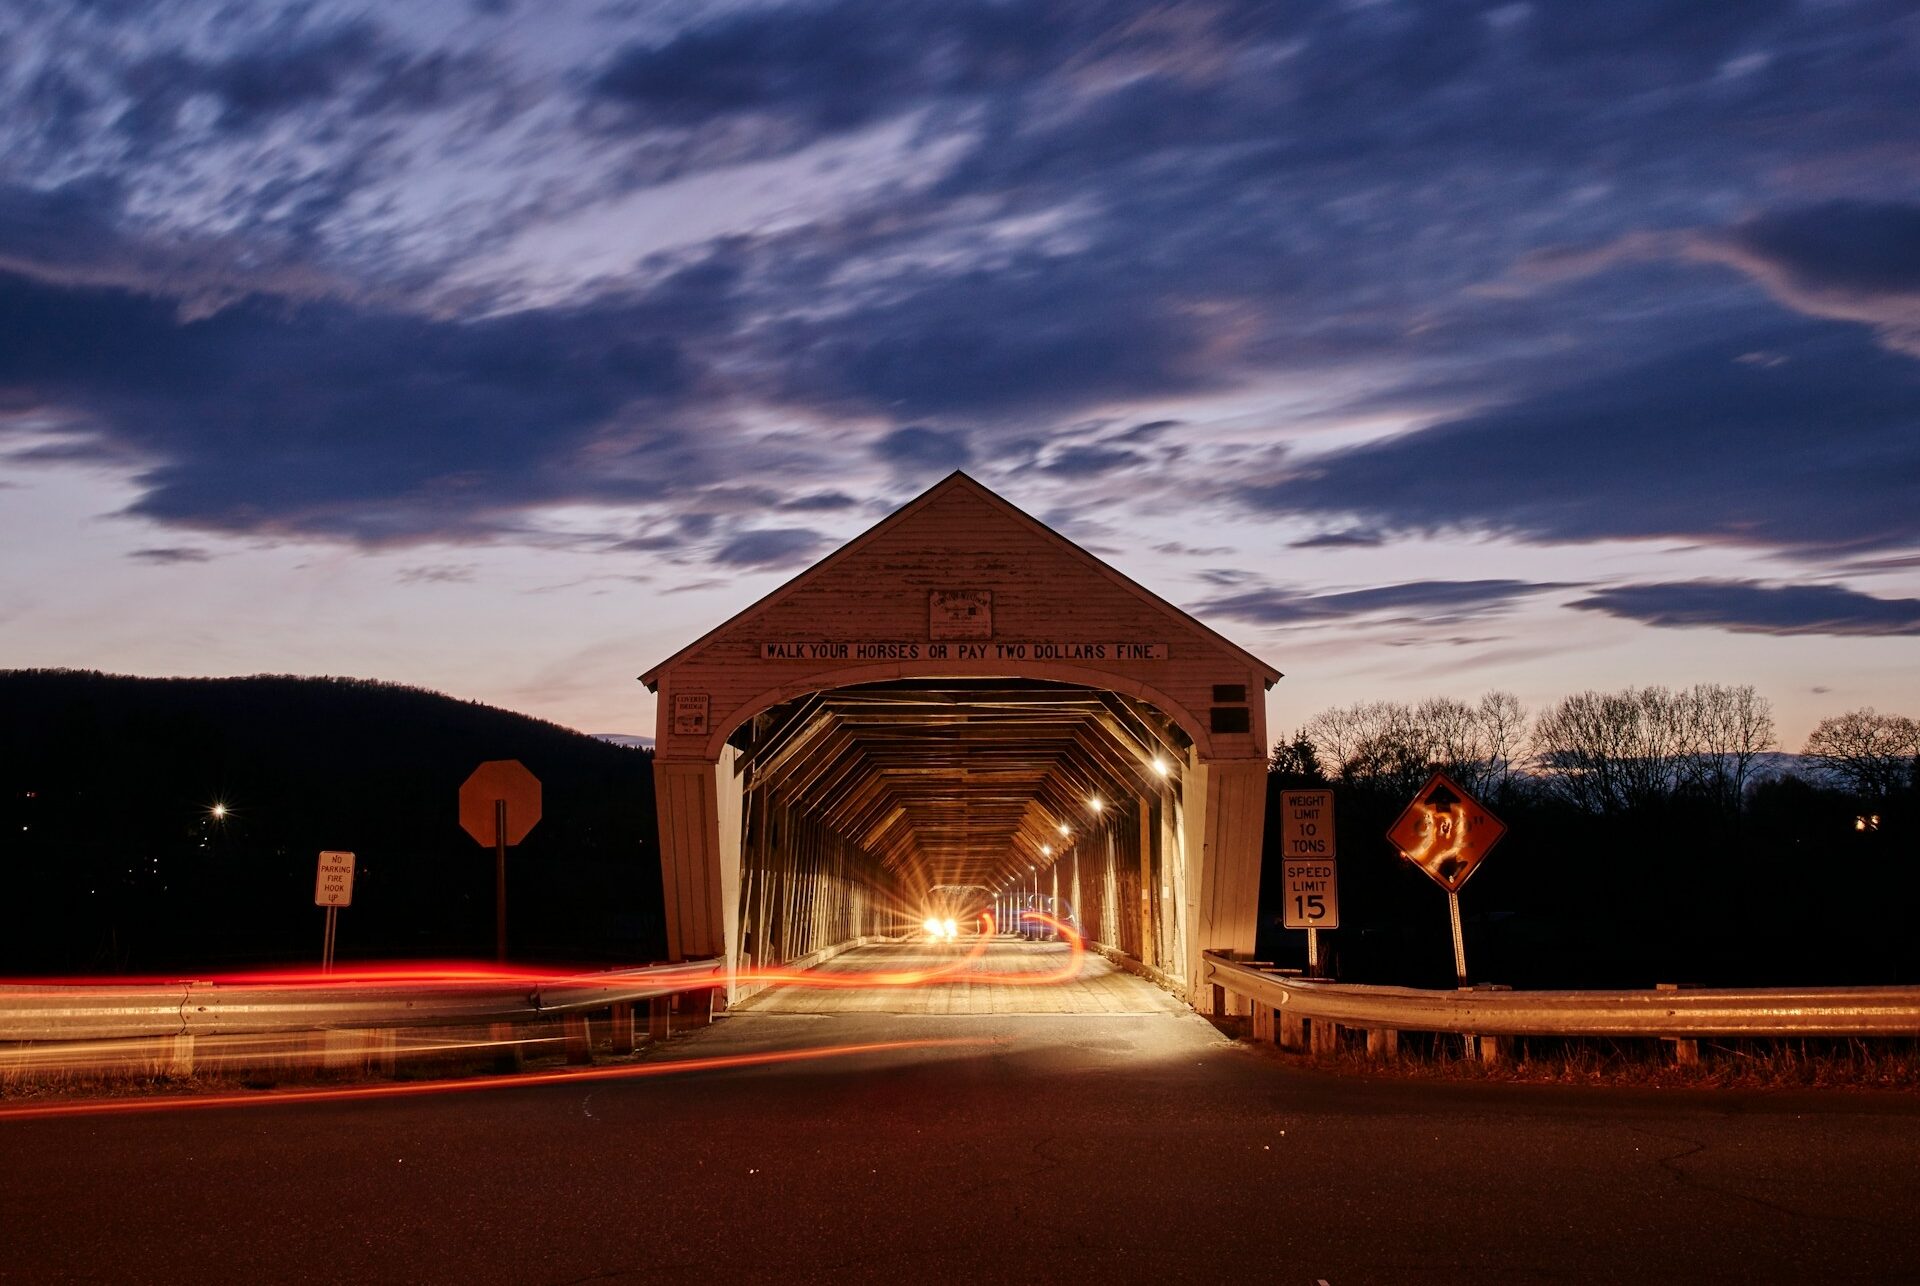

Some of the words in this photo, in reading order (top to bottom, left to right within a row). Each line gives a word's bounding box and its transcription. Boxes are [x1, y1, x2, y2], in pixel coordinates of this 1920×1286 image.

[767, 644, 805, 659] WALK
[809, 644, 849, 659] YOUR
[856, 644, 920, 659] HORSES
[928, 644, 948, 659] OR
[958, 644, 988, 659] PAY
[996, 644, 1026, 659] TWO
[1034, 644, 1106, 659] DOLLARS
[1116, 644, 1161, 659] FINE.
[1288, 796, 1325, 806] WEIGHT
[1294, 809, 1320, 820] LIMIT
[1300, 823, 1317, 836] 10
[1292, 839, 1326, 853] TONS
[331, 855, 343, 864] NO
[321, 865, 351, 874] PARKING
[1287, 866, 1331, 878] SPEED
[327, 874, 343, 883] FIRE
[324, 884, 345, 892] HOOK
[1292, 881, 1327, 892] LIMIT
[328, 893, 339, 903] UP
[1295, 895, 1326, 919] 15
